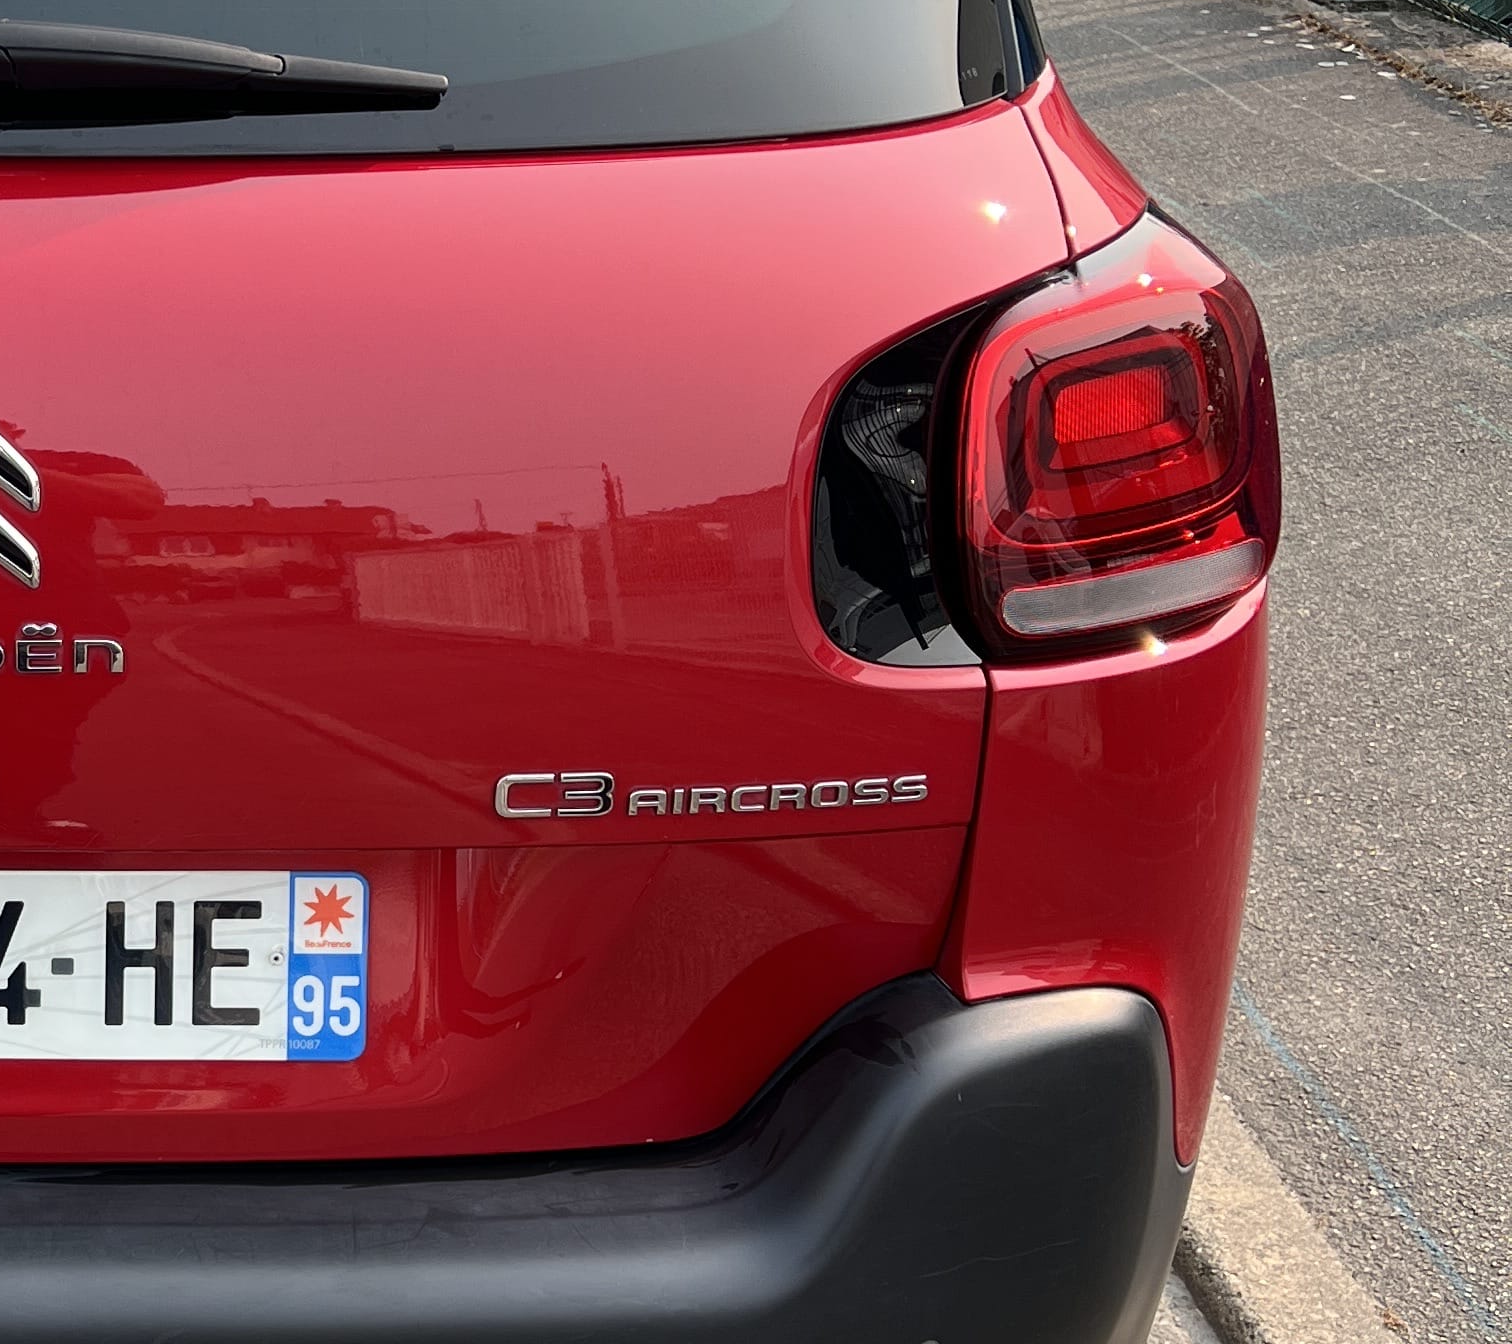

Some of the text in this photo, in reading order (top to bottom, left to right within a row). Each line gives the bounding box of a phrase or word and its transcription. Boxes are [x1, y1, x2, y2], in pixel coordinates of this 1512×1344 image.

[494, 772, 929, 818] C3 AIRCROSS
[292, 974, 361, 1037] 95
